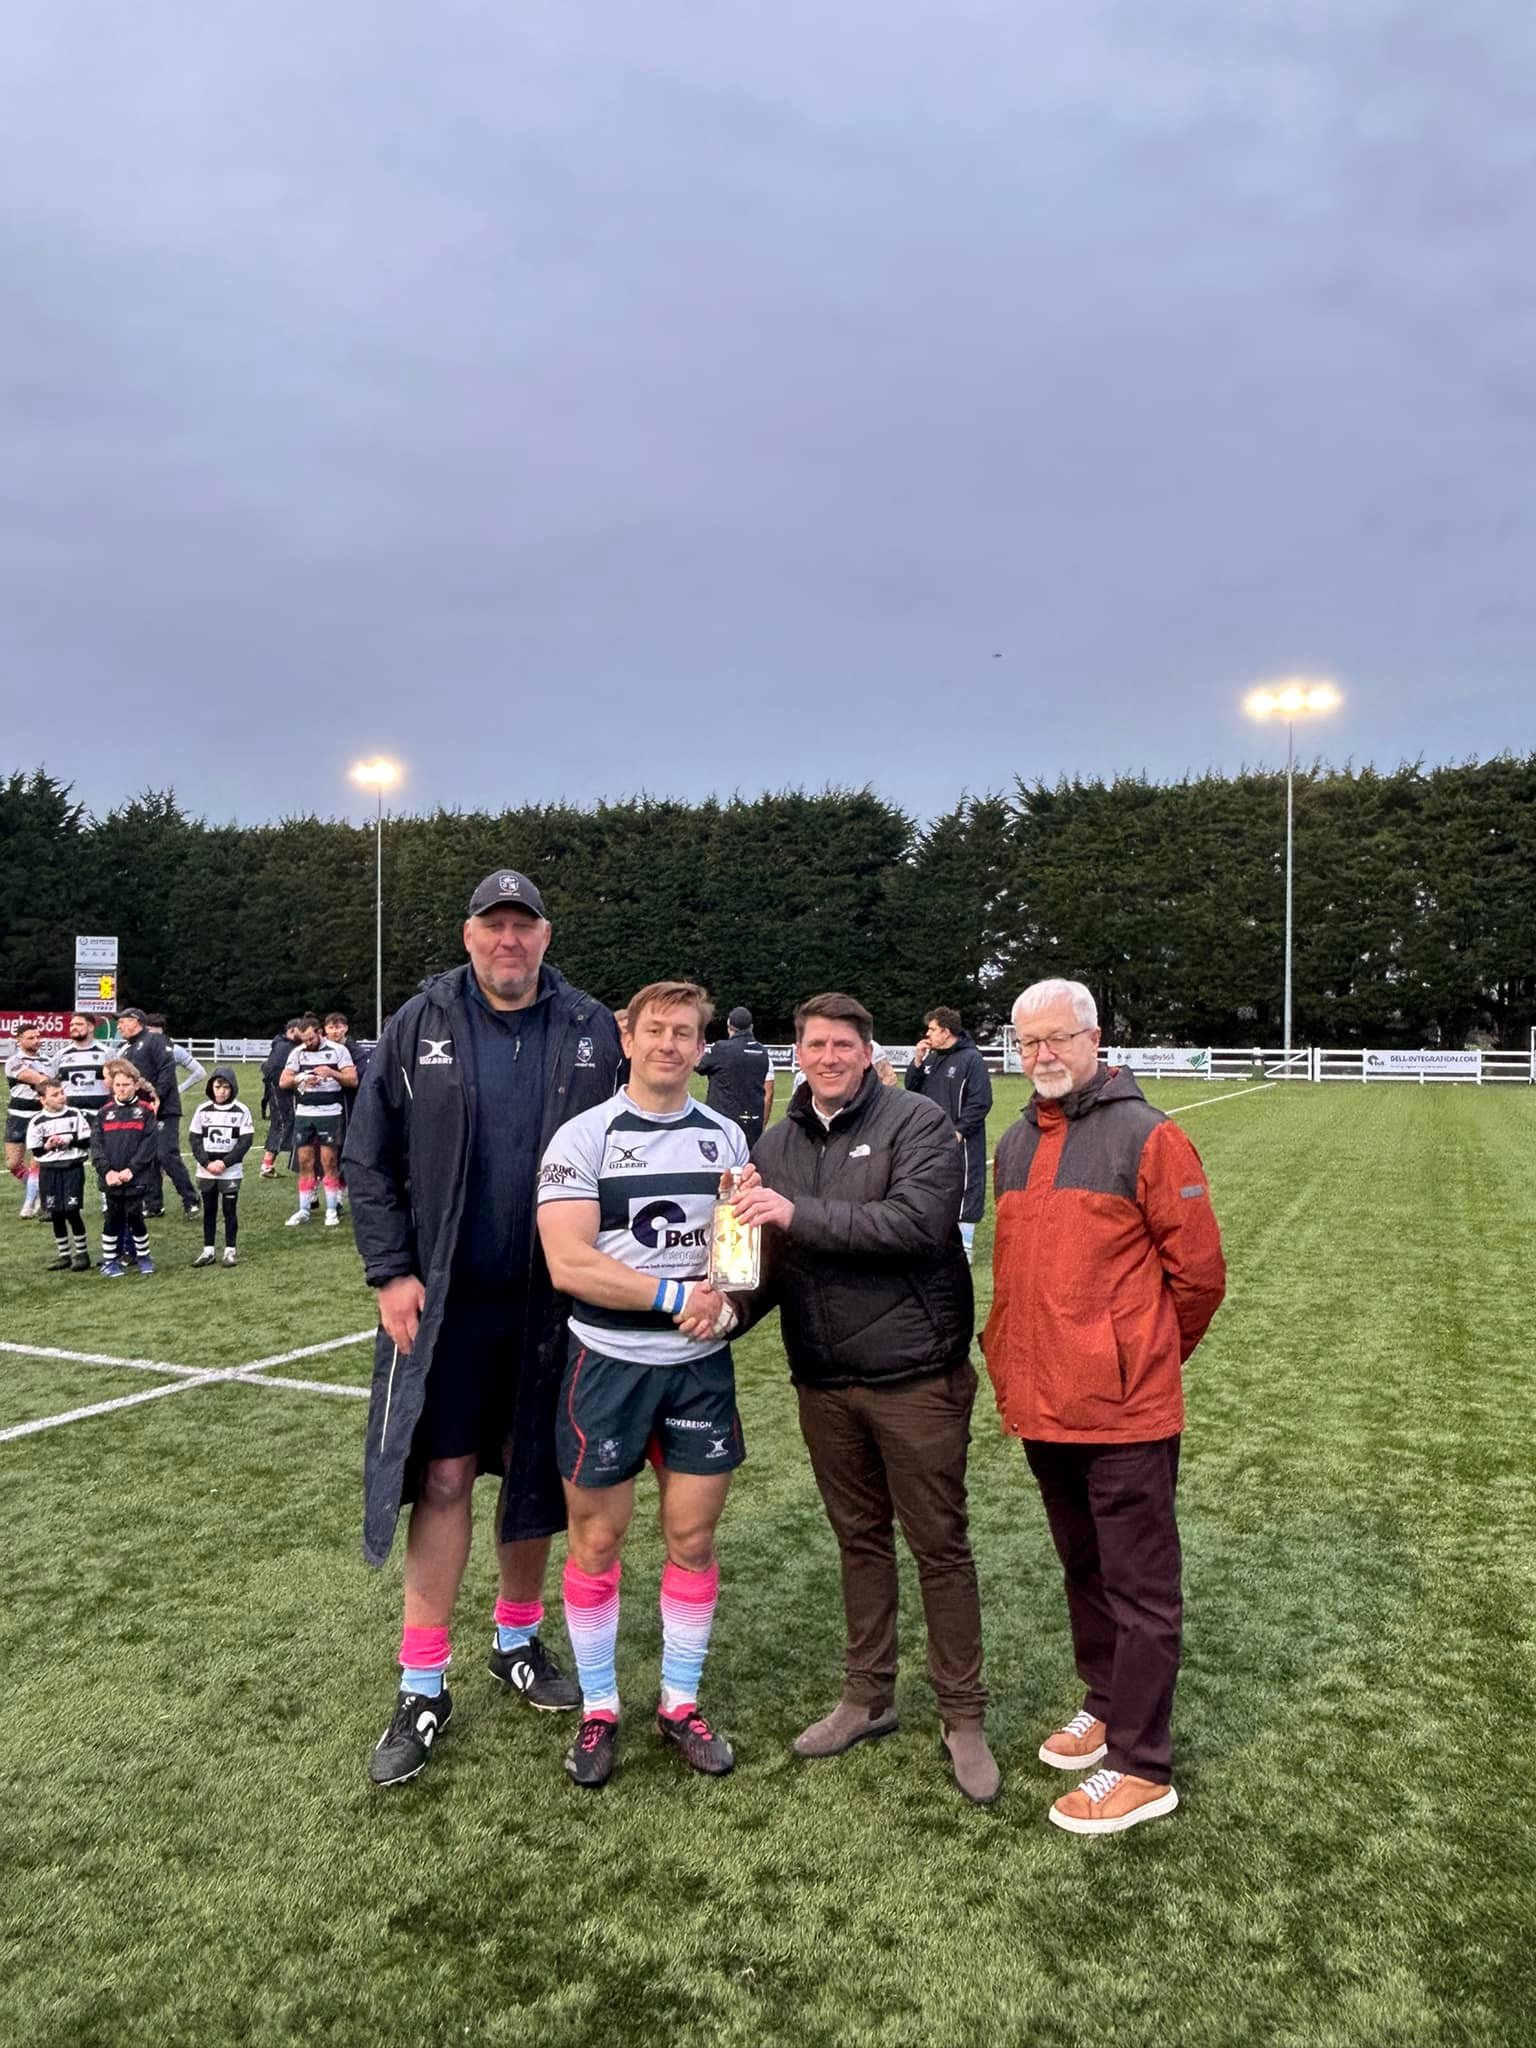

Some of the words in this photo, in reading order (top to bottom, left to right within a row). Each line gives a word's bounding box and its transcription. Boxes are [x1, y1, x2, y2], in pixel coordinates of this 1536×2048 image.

[0, 1014, 64, 1036] ugby365
[419, 1057, 453, 1065] GILBERT
[609, 1161, 649, 1170] GILBERT
[665, 1228, 708, 1249] Bell
[665, 1417, 713, 1429] SOVEREIGN
